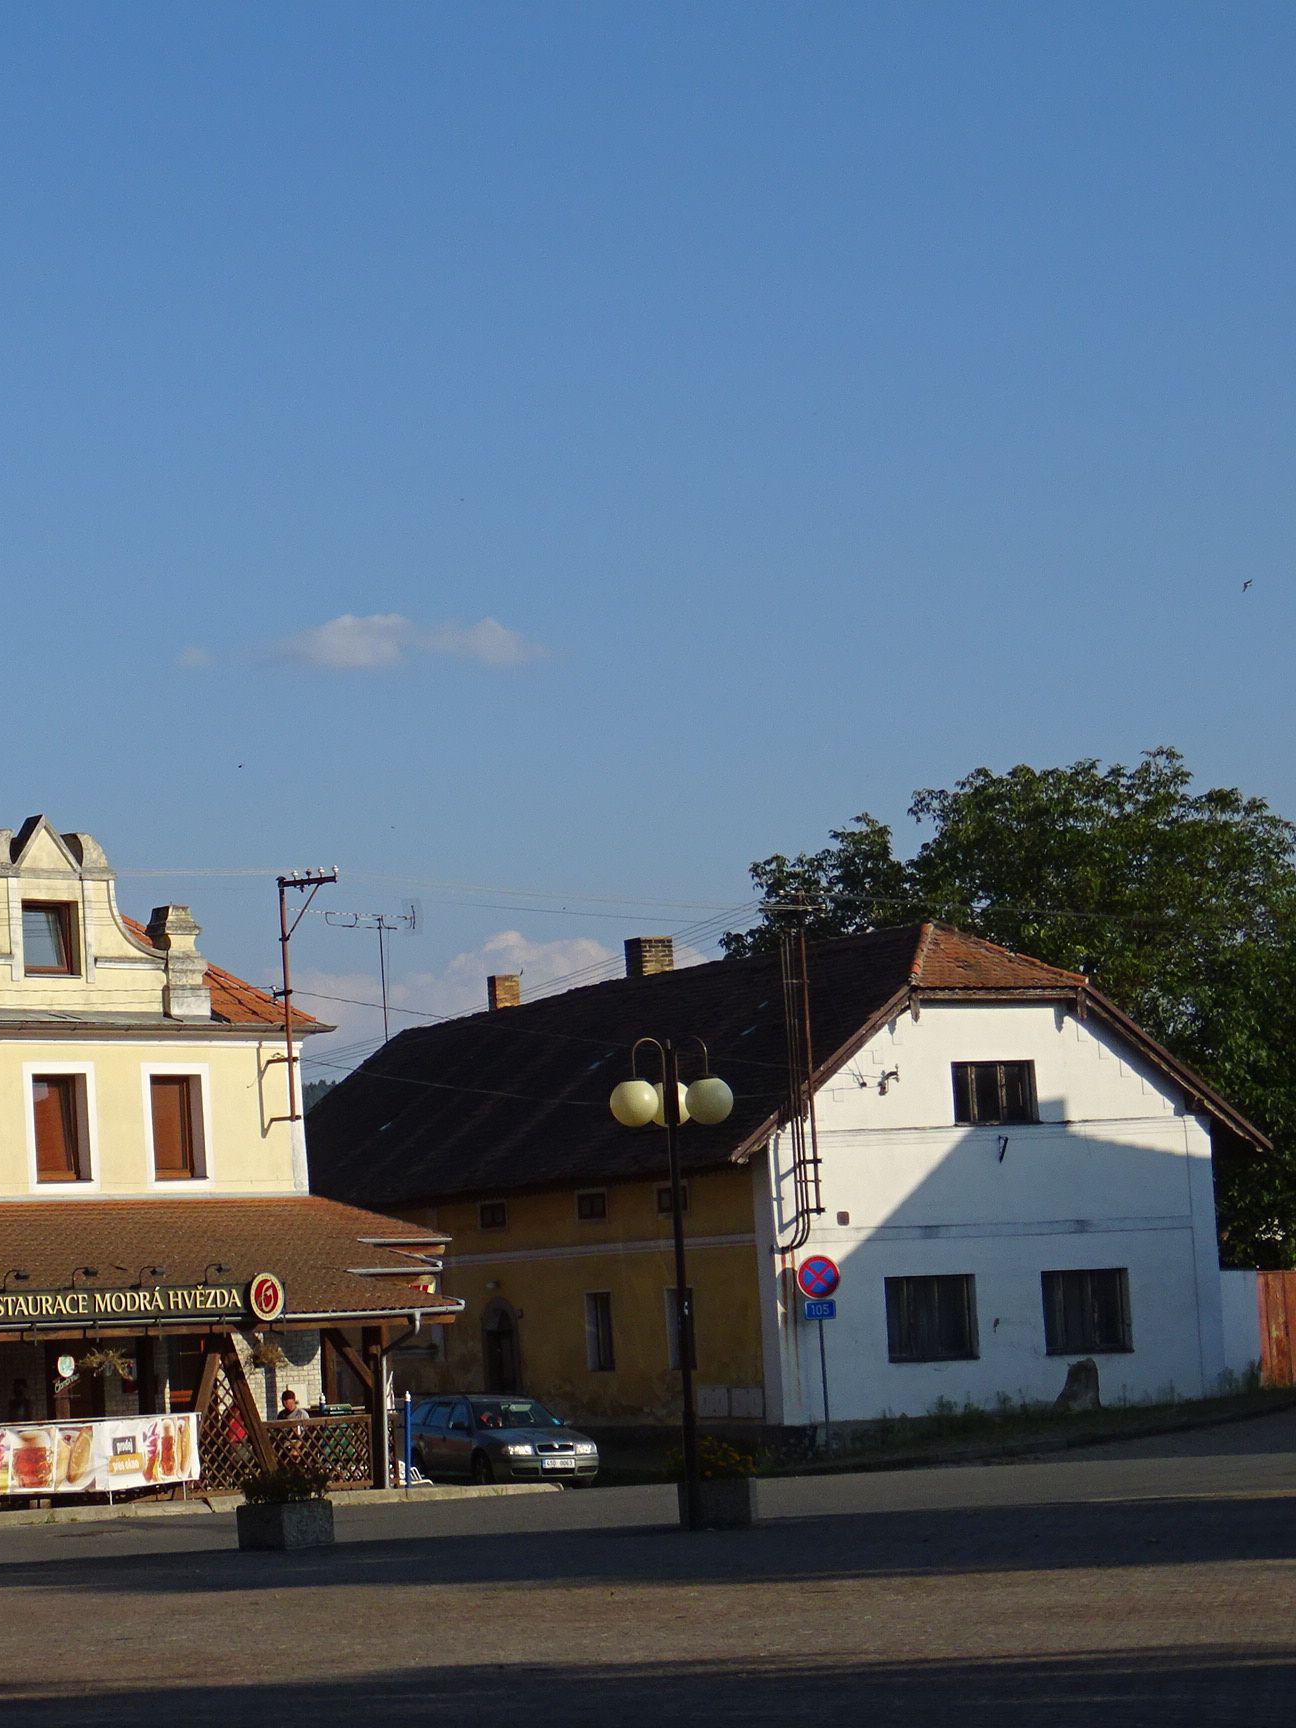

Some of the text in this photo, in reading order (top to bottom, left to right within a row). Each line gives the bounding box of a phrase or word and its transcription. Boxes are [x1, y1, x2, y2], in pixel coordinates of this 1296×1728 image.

[95, 1286, 164, 1312] MODRÁ
[168, 1285, 241, 1309] HVĚZDA
[811, 1304, 830, 1315] 105
